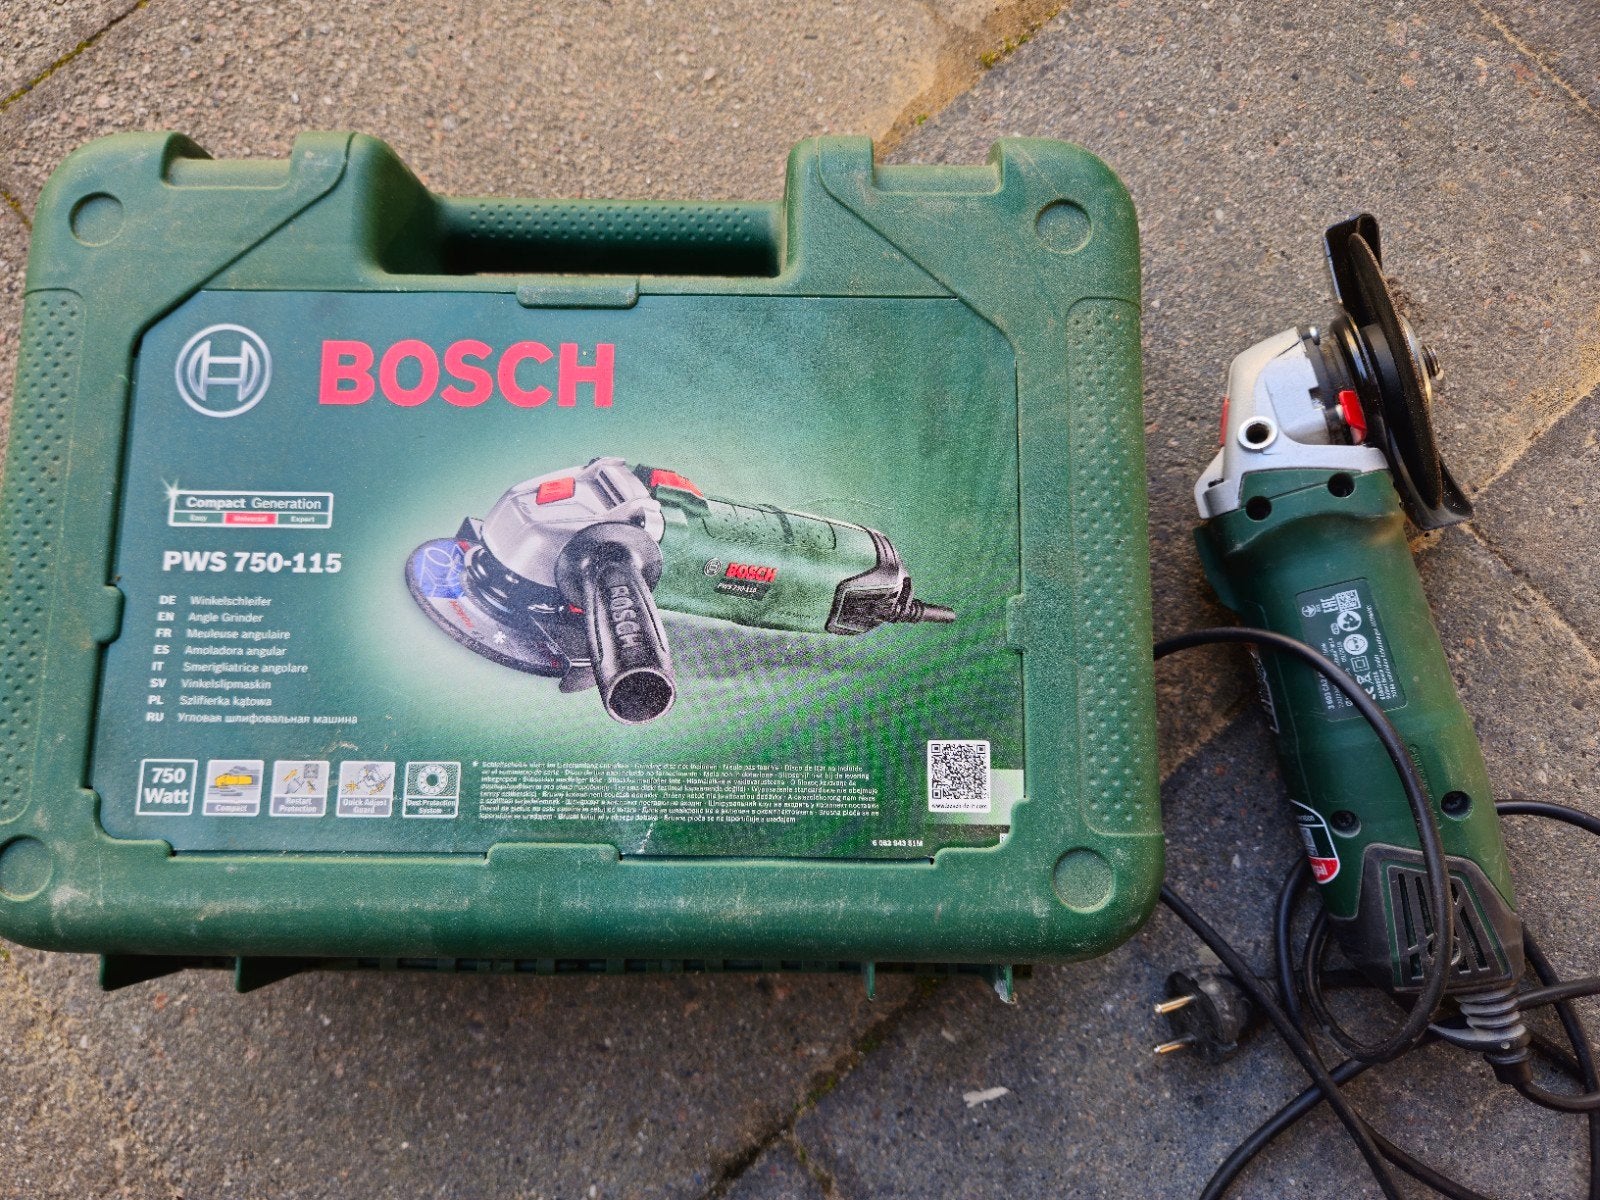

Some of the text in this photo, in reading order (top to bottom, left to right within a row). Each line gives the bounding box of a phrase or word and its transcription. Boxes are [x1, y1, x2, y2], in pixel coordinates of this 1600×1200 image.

[319, 339, 615, 408] BOSCH
[186, 496, 322, 510] Compact Generation
[291, 515, 315, 523] Expert
[162, 551, 342, 573] PWS 750-115
[725, 563, 779, 582] BOSCH
[159, 595, 271, 606] DE Winkelschleifer
[157, 612, 264, 624] EN Angle Grinder
[608, 585, 642, 648] BOSCH
[155, 628, 291, 641] FR Meuleuse angulaire
[153, 645, 287, 658] ES Amoladora angular
[151, 661, 308, 674] IT Smerigliatrice angolare
[149, 678, 272, 690] SV Vinkelslipmaskin
[147, 695, 272, 707] PL Szlifierka kątowa
[146, 712, 164, 722] RU
[178, 712, 358, 725] Угловая шлифовальная машина
[151, 768, 185, 783] 750
[144, 788, 189, 804] Watt
[215, 804, 248, 813] Compact
